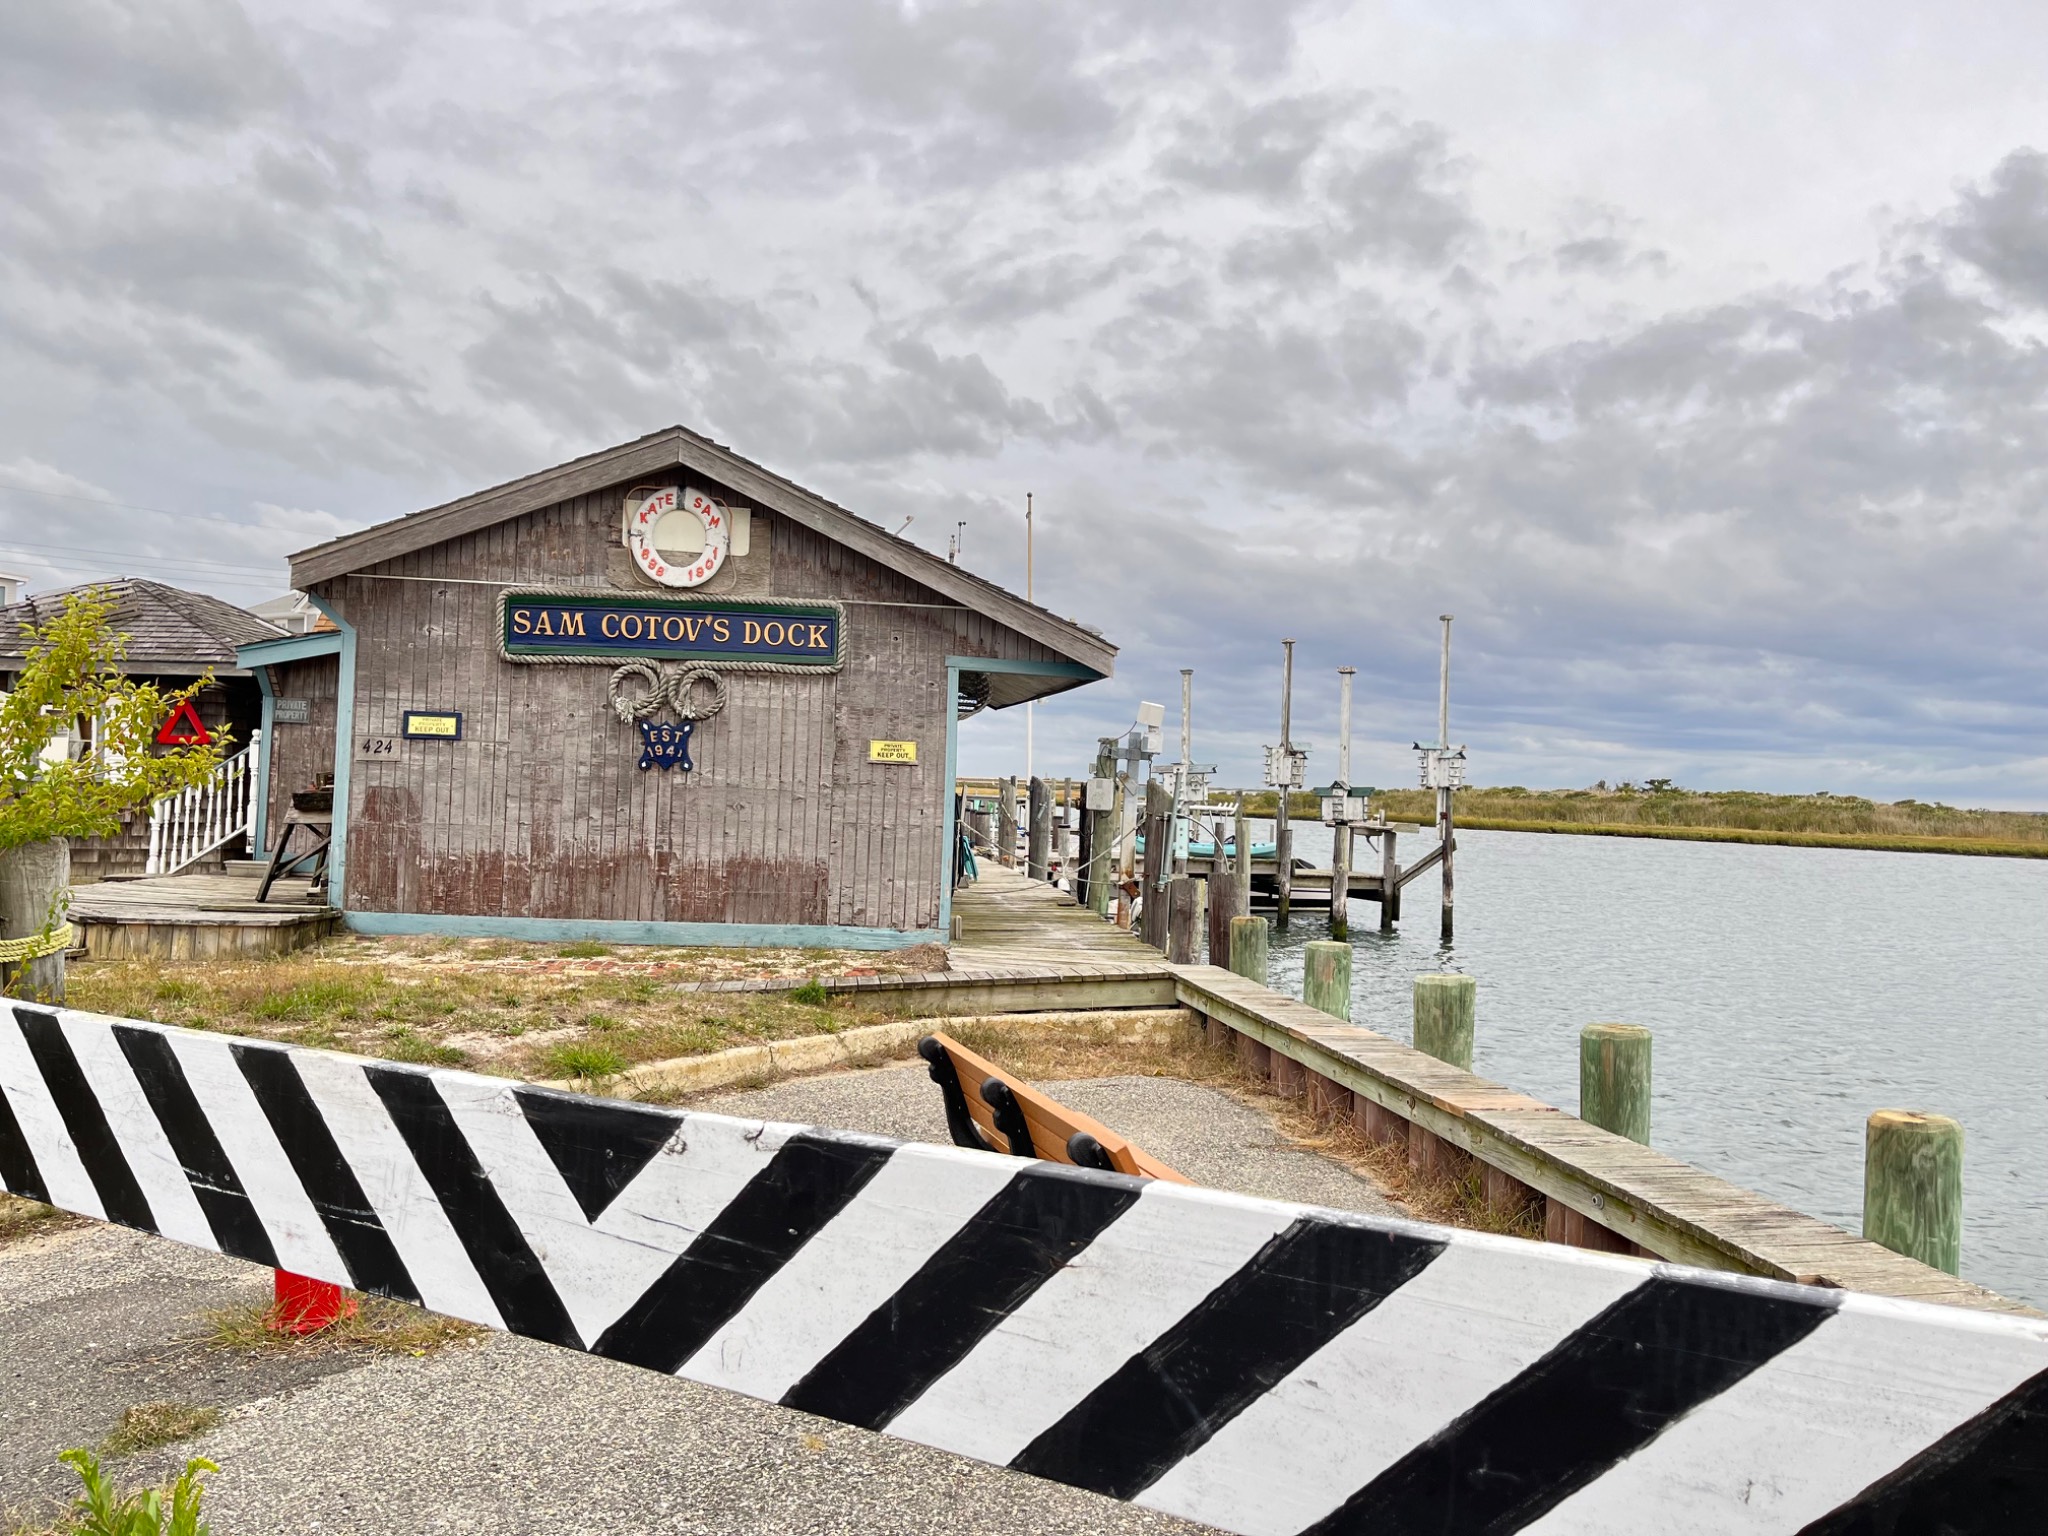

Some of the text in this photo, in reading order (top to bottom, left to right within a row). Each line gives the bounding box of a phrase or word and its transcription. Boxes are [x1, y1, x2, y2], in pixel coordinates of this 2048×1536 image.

[640, 494, 674, 524] KATE
[693, 497, 720, 528] SAM
[513, 609, 829, 648] SAM COTOV'S DOCK
[276, 700, 308, 710] PRIVATE
[275, 710, 309, 720] PROPERTY
[650, 730, 684, 744] EST
[362, 739, 393, 754] 424
[646, 744, 683, 758] 1941
